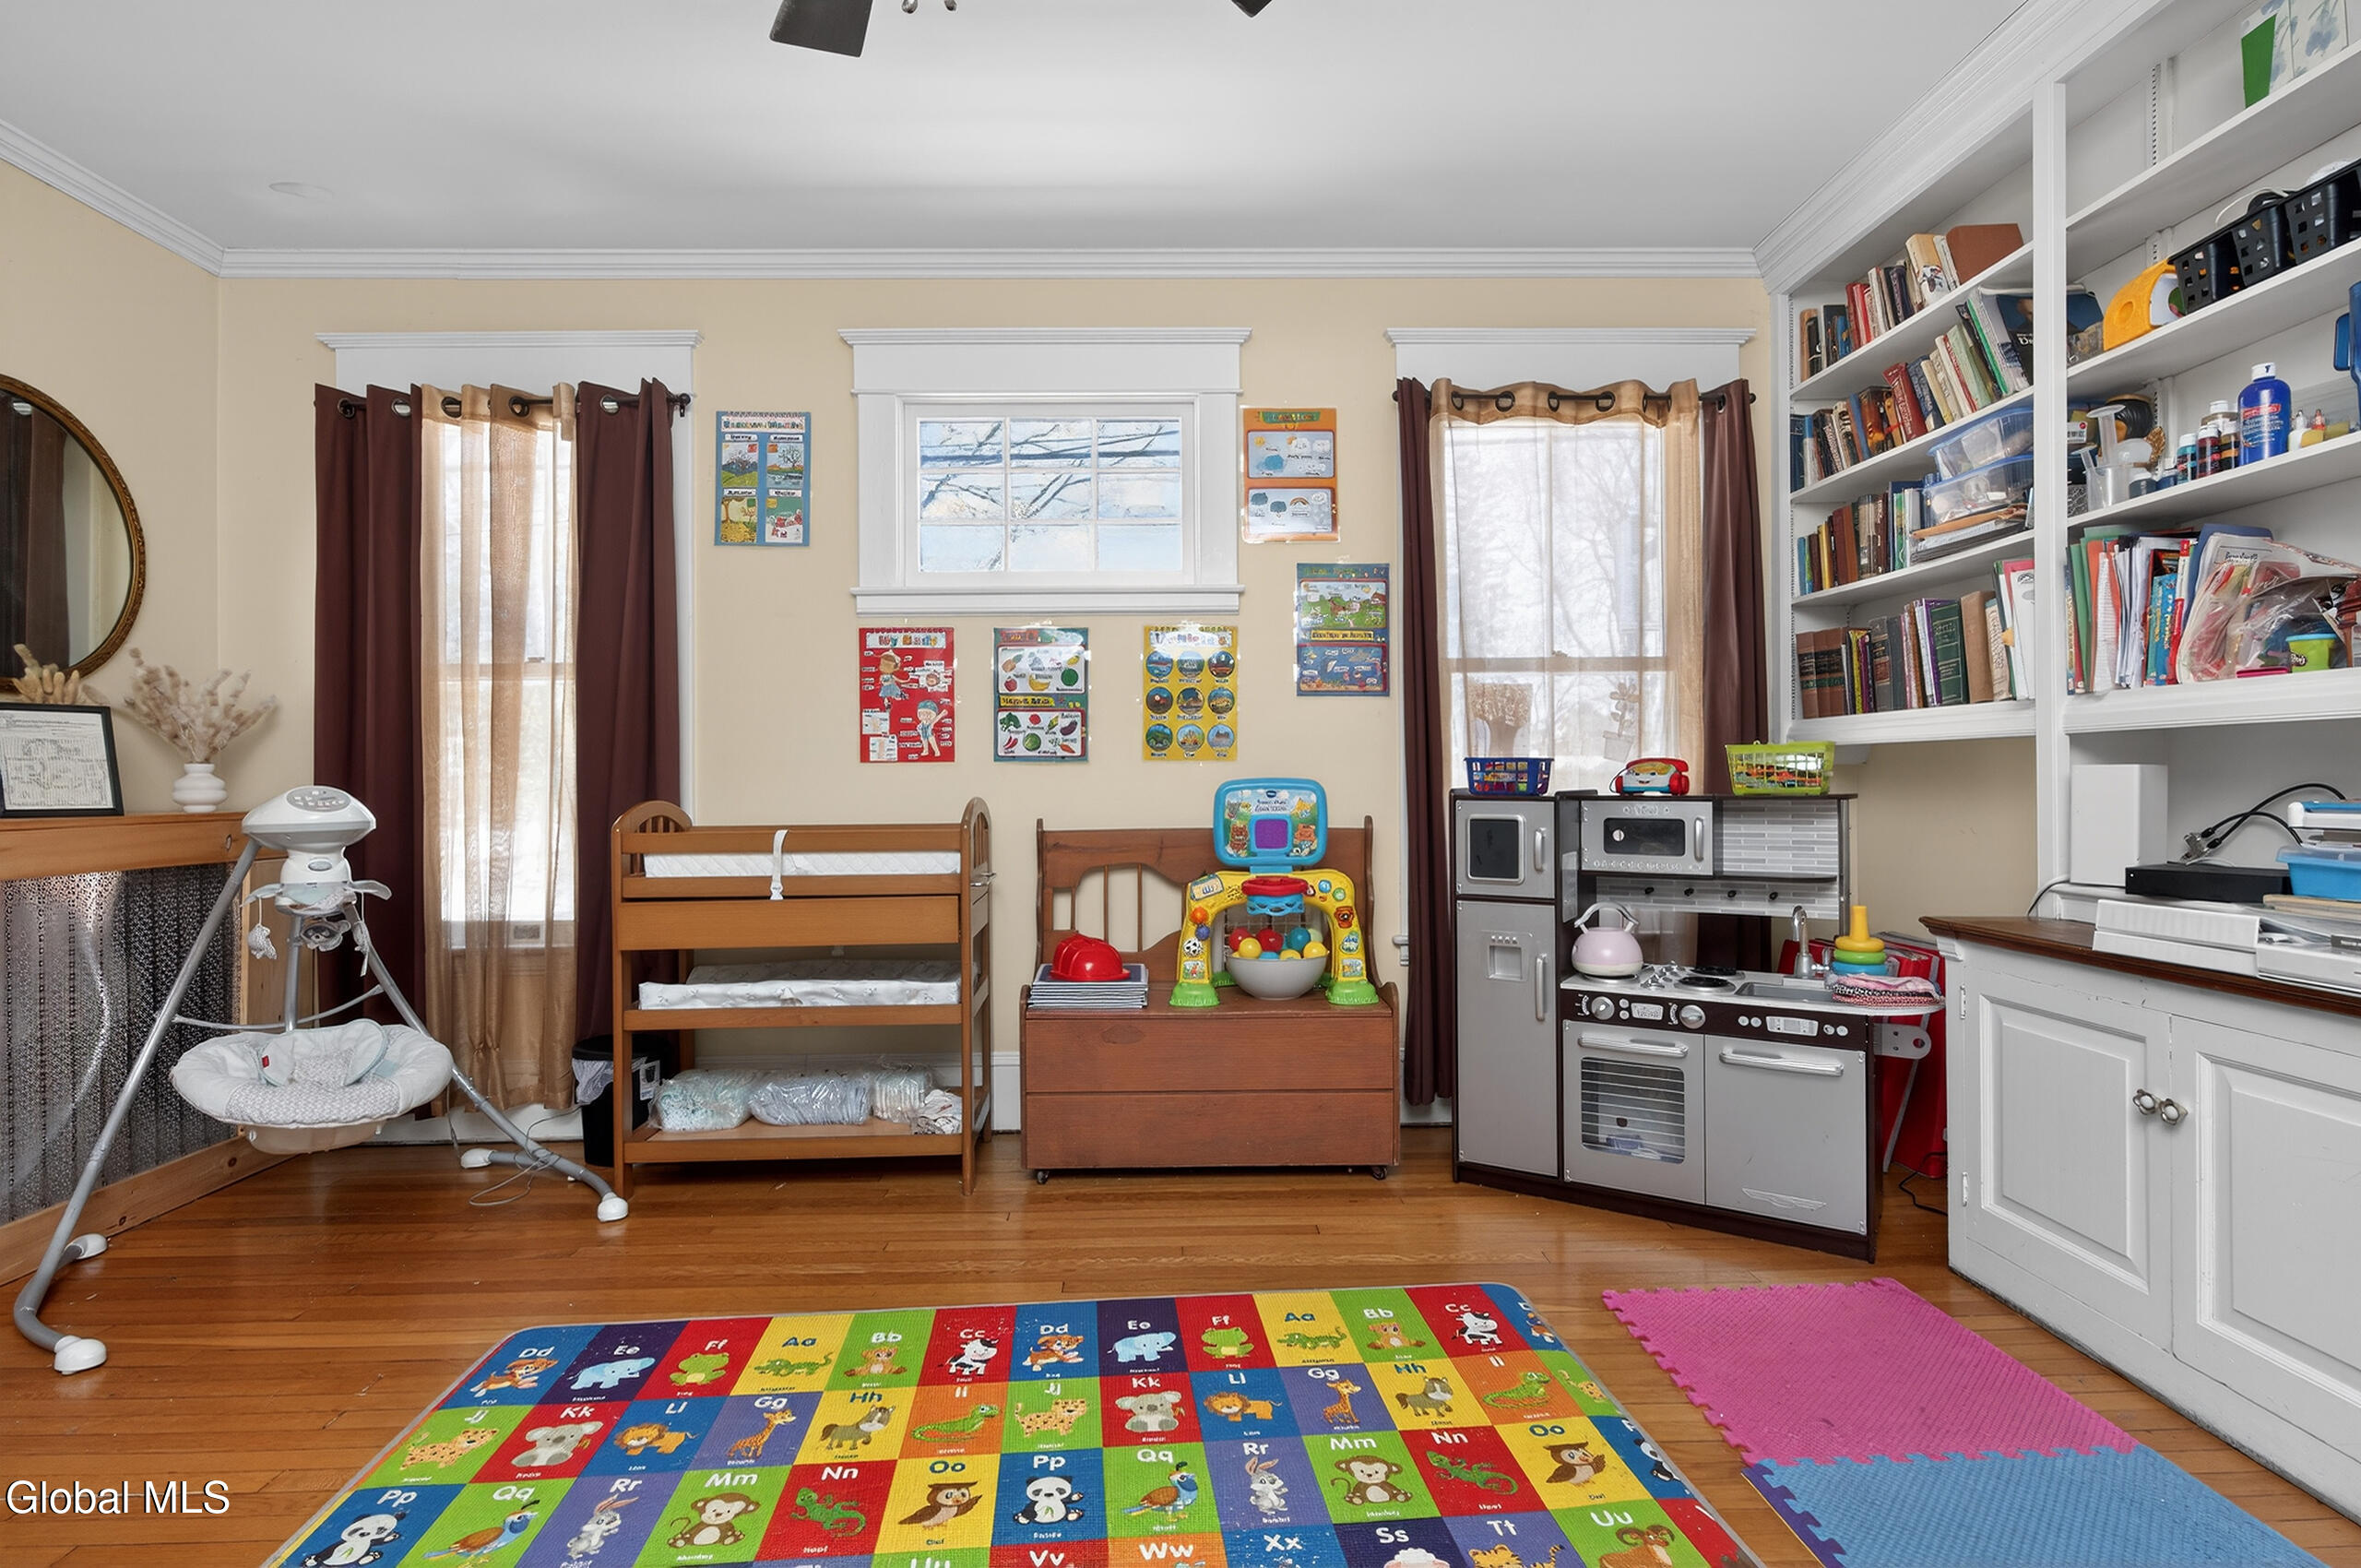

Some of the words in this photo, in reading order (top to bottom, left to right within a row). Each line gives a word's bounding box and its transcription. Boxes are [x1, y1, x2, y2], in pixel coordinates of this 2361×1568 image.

[1363, 1308, 1394, 1319] Bb
[1444, 1303, 1471, 1313] Cc
[1285, 1313, 1316, 1323] Aa
[959, 1328, 986, 1339] Cc
[1039, 1323, 1069, 1335] Dd
[781, 1336, 817, 1348] Aa
[871, 1331, 903, 1344] Bb
[518, 1346, 555, 1359] Dd
[1307, 1367, 1340, 1382] Gg
[1394, 1362, 1427, 1374] Hh
[1132, 1376, 1161, 1388] Kk
[1228, 1372, 1246, 1384] Ll
[753, 1396, 789, 1411] Gg
[849, 1391, 883, 1403] Hh
[560, 1406, 595, 1419] Kk
[665, 1401, 688, 1414] Ll
[1430, 1431, 1468, 1444] Nn
[1528, 1424, 1565, 1437] Oo
[1242, 1442, 1269, 1456] Rr
[1330, 1436, 1377, 1451] Mm
[1033, 1455, 1066, 1471] Pp
[1136, 1448, 1174, 1464] Qq
[821, 1466, 859, 1481] Nn
[929, 1460, 966, 1474] Oo
[609, 1478, 643, 1493] Rr
[704, 1472, 758, 1488] Mm
[376, 1490, 418, 1508] Pp
[492, 1485, 536, 1503] Qq
[1590, 1510, 1633, 1527] Uu
[1375, 1526, 1410, 1544] Ss
[1486, 1519, 1517, 1537] Tt
[1264, 1534, 1303, 1552] Xx
[1138, 1541, 1194, 1561] Ww
[1029, 1550, 1065, 1568] Vv
